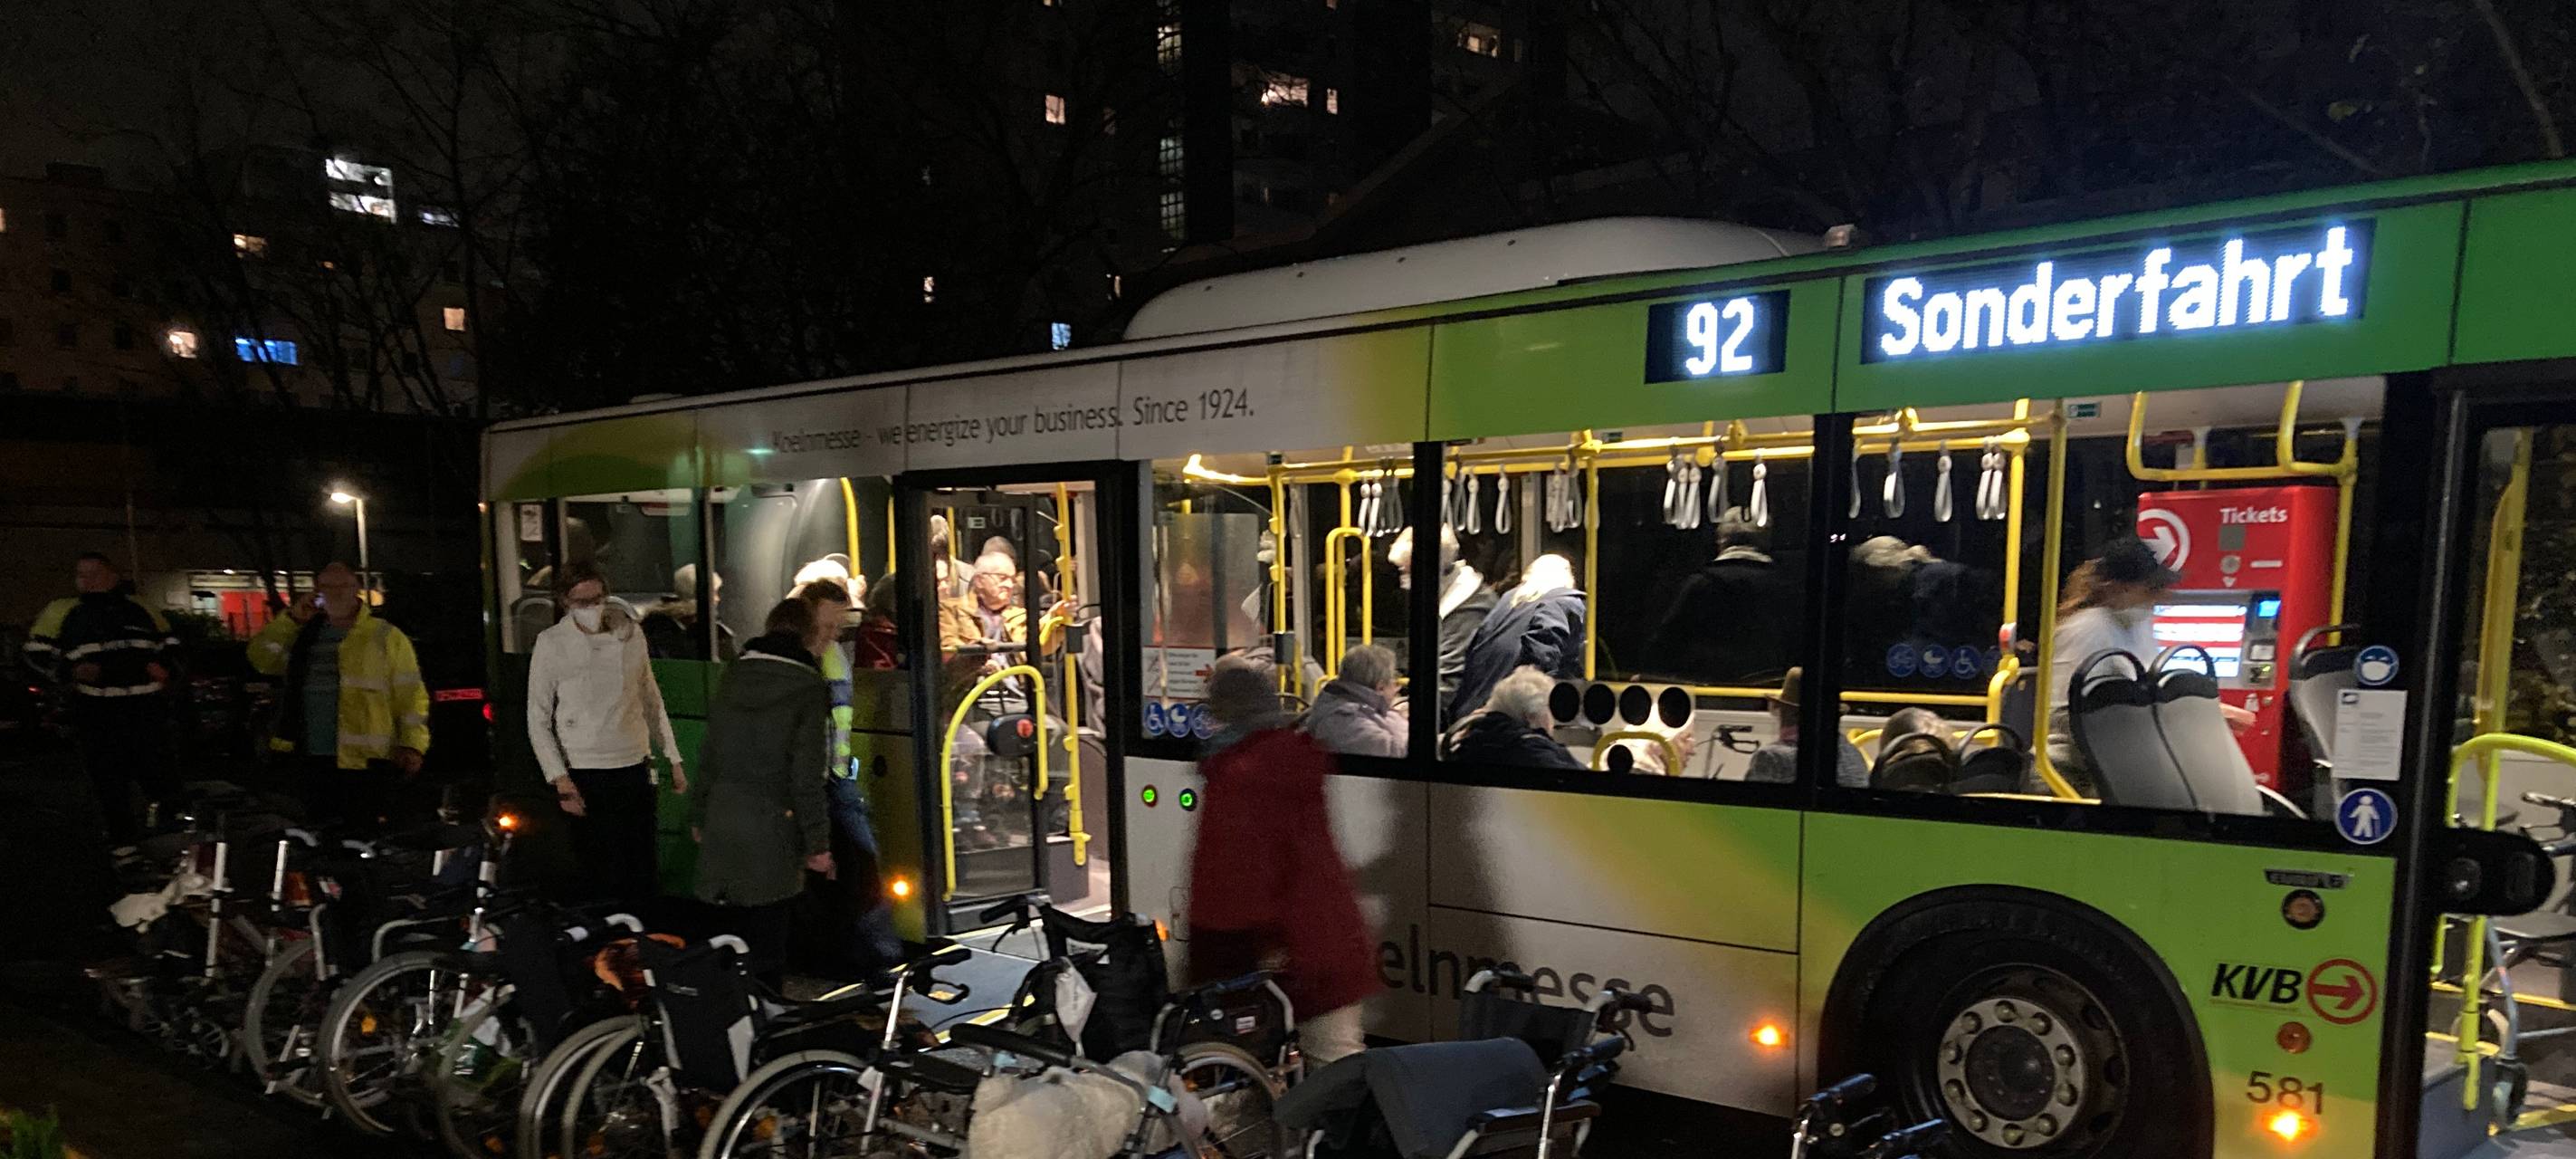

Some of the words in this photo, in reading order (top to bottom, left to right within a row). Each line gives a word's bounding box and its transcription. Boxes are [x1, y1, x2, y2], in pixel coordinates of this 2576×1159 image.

[1879, 225, 2354, 357] Sonderfahrt
[1684, 296, 1755, 377] 92
[875, 424, 902, 445] we
[905, 414, 981, 447] energize
[986, 413, 1028, 444] your
[1132, 396, 1188, 426] Since
[1198, 388, 1255, 420] 1924.
[2219, 505, 2288, 523] Tickets
[2210, 963, 2303, 1005] KVB
[2246, 1069, 2324, 1116] 581
